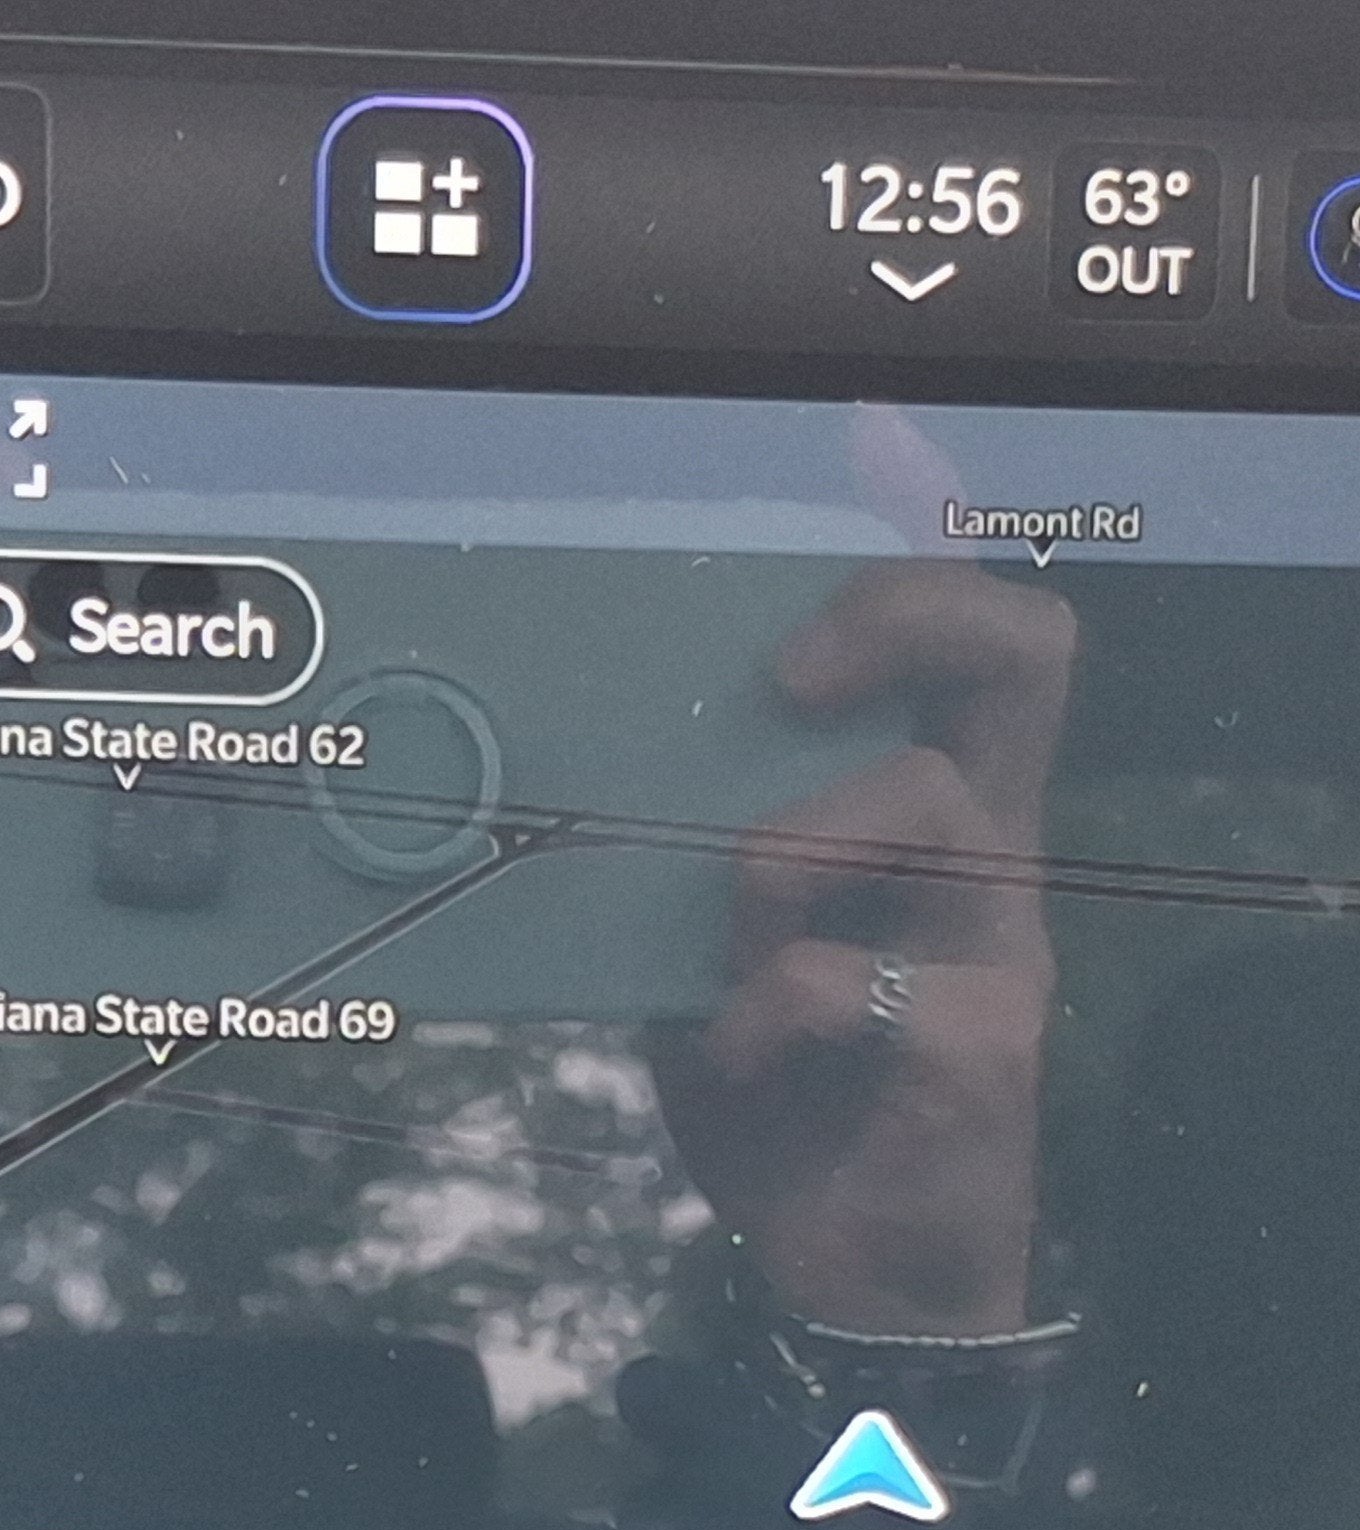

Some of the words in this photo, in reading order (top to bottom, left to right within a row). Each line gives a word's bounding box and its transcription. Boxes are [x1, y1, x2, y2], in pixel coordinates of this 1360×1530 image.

[820, 160, 1024, 237] 12:56
[1083, 167, 1193, 227] 63°
[1075, 243, 1195, 296] OUT
[945, 500, 1083, 540] Lamont
[1091, 504, 1142, 540] Rd
[68, 596, 278, 660] Search
[62, 716, 178, 763] State
[187, 720, 299, 765] Road
[308, 724, 366, 767] 62
[94, 993, 210, 1038] State
[218, 996, 330, 1040] Road
[338, 999, 397, 1042] 69
